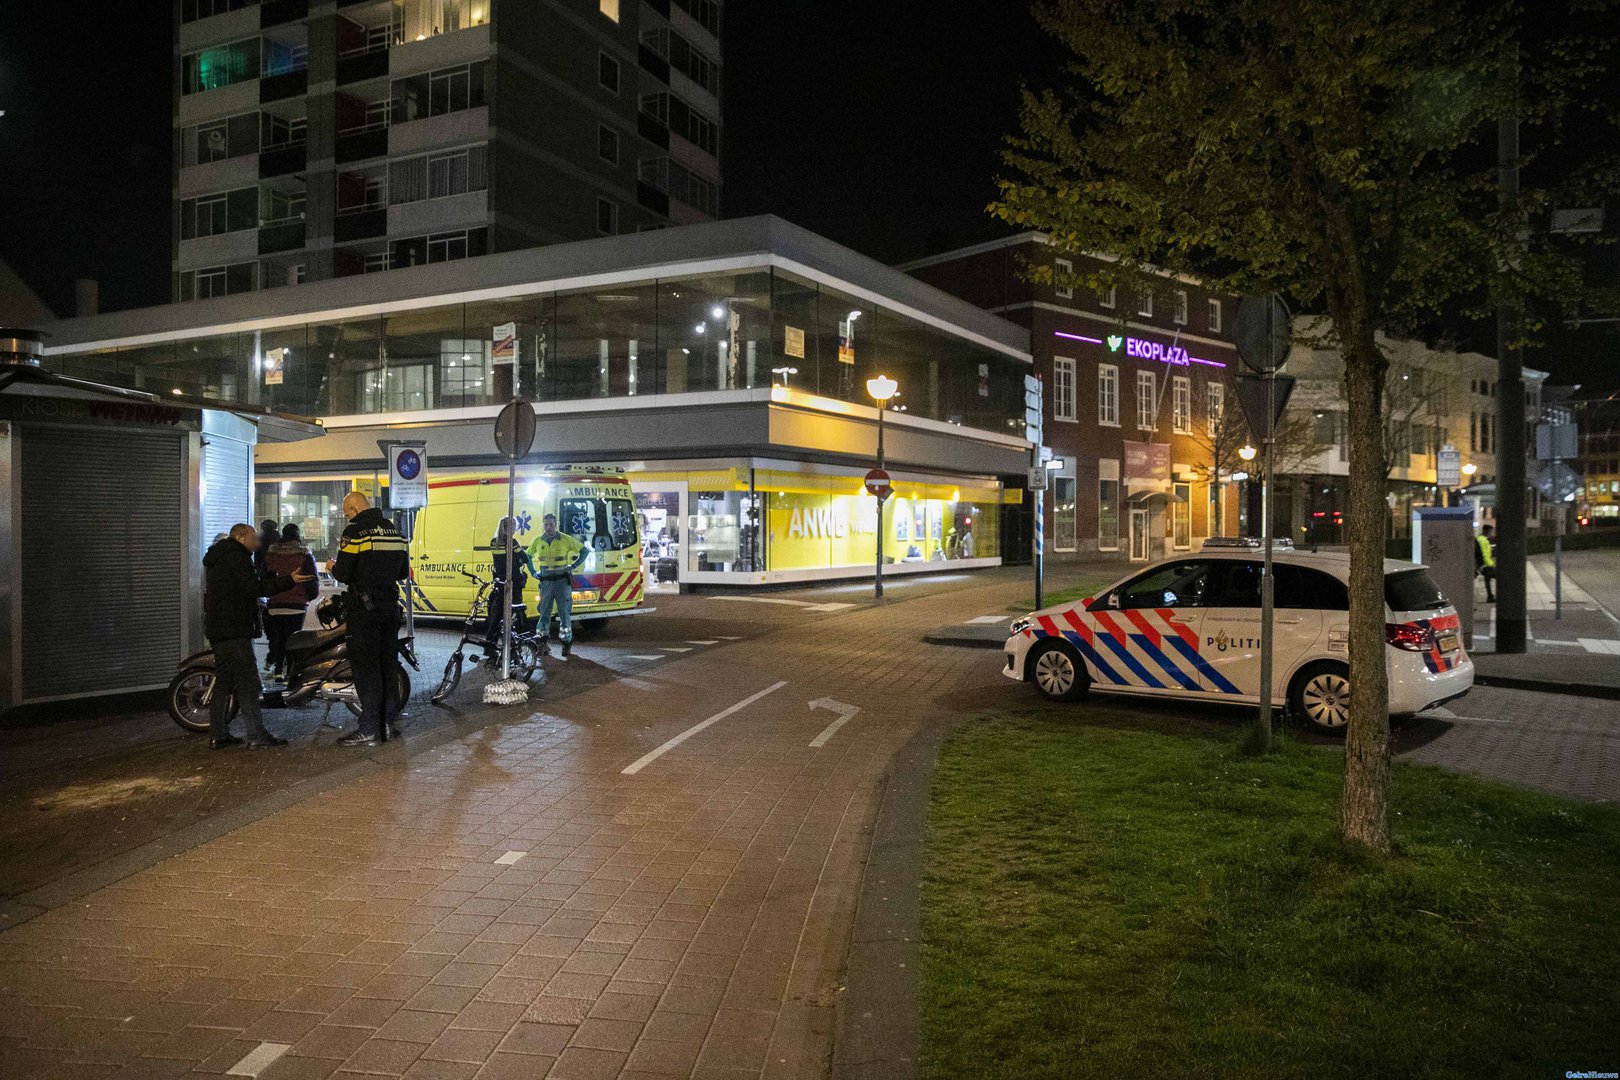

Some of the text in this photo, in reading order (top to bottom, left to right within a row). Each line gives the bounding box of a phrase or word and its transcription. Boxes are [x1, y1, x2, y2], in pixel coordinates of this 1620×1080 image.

[1127, 337, 1190, 366] EKOPLAZA
[20, 397, 84, 418] KIOSK
[788, 507, 847, 539] ANWB
[420, 563, 467, 573] AMBULANCE
[1207, 634, 1260, 652] POLITI
